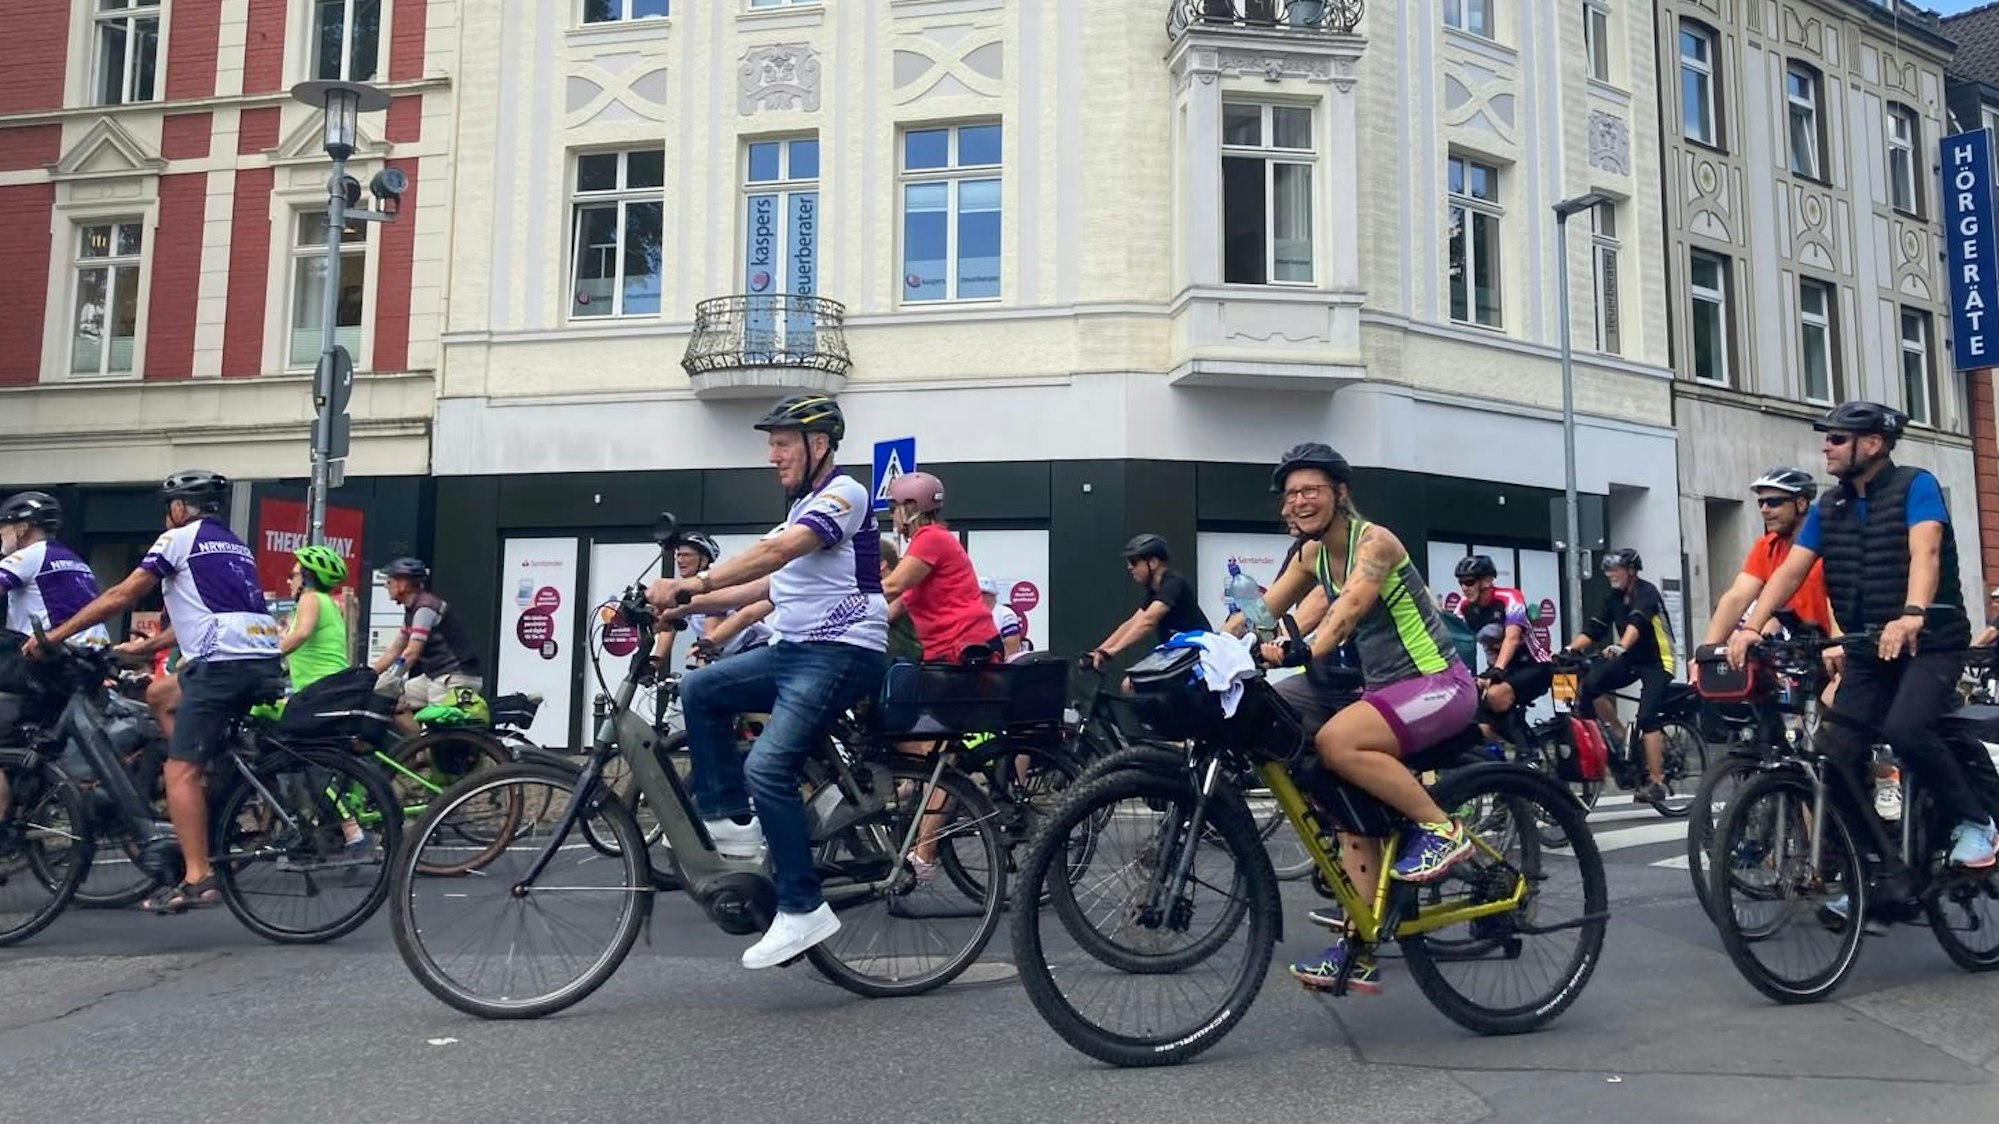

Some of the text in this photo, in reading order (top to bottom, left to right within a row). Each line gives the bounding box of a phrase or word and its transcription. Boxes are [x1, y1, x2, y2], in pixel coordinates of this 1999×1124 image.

[750, 199, 774, 266] kaspers
[1953, 143, 1985, 356] HÖRGERÄTE
[1155, 1009, 1231, 1053] SCHWALBE
